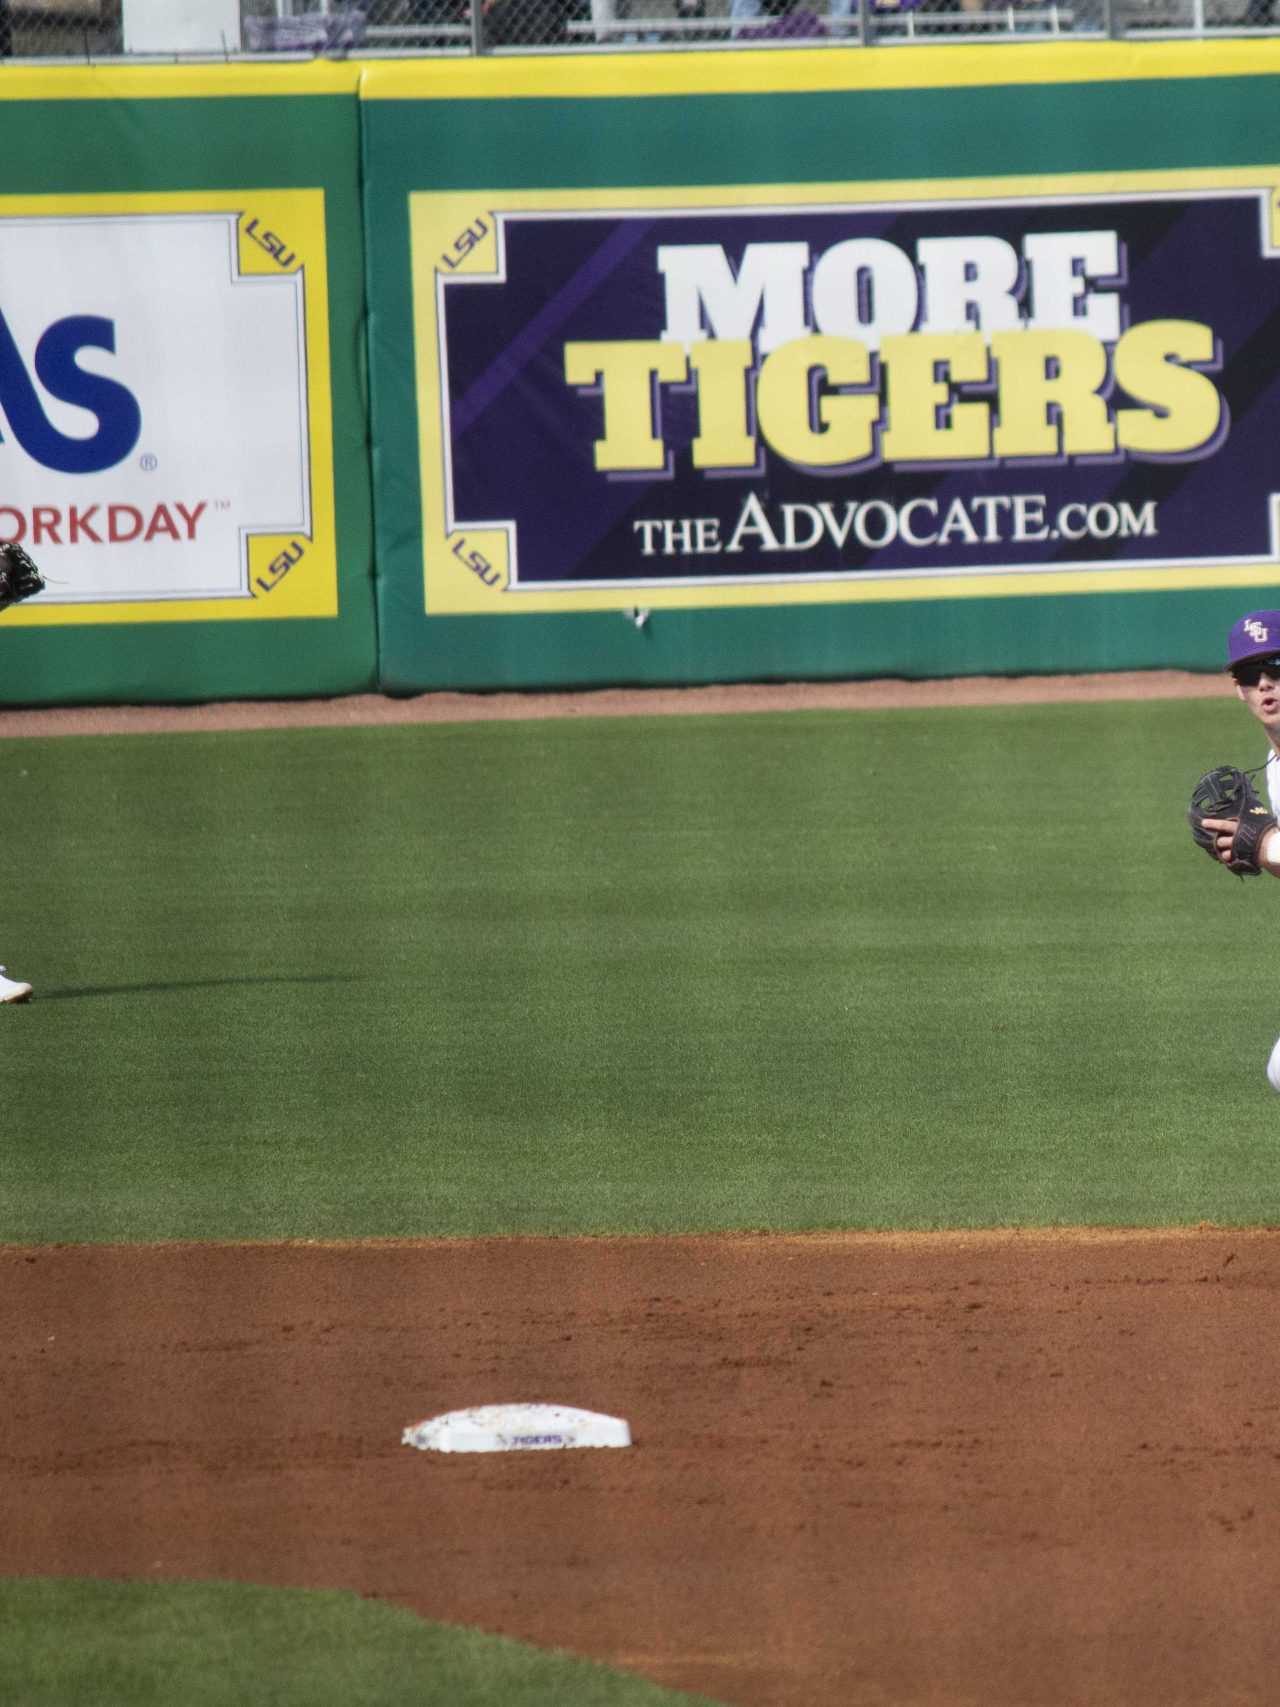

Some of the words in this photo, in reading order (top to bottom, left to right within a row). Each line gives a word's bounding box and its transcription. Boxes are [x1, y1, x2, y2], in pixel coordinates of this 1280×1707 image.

[244, 219, 297, 269] LSU
[442, 218, 489, 272] LSU
[657, 230, 1122, 352] MORE
[563, 319, 1226, 475] TIGERS
[255, 541, 305, 594] LSU
[451, 538, 502, 588] LSU
[1243, 619, 1268, 643] LSU
